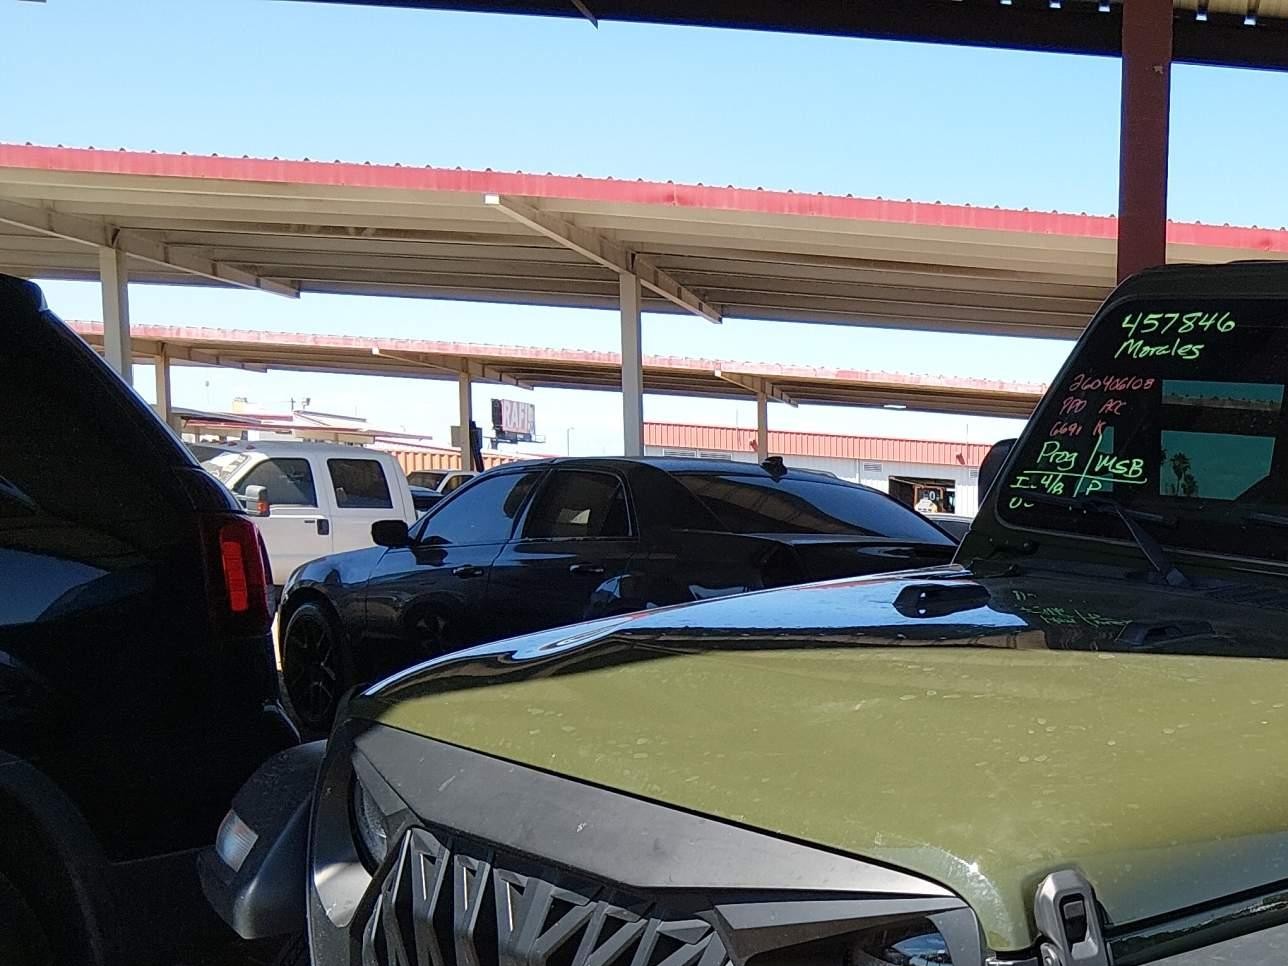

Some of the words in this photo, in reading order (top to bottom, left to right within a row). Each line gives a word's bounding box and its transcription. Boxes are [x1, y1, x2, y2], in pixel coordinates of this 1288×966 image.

[1121, 311, 1236, 338] 457846
[1114, 337, 1205, 360] Morales
[1036, 440, 1079, 471] Prog
[1094, 454, 1144, 478] MSB
